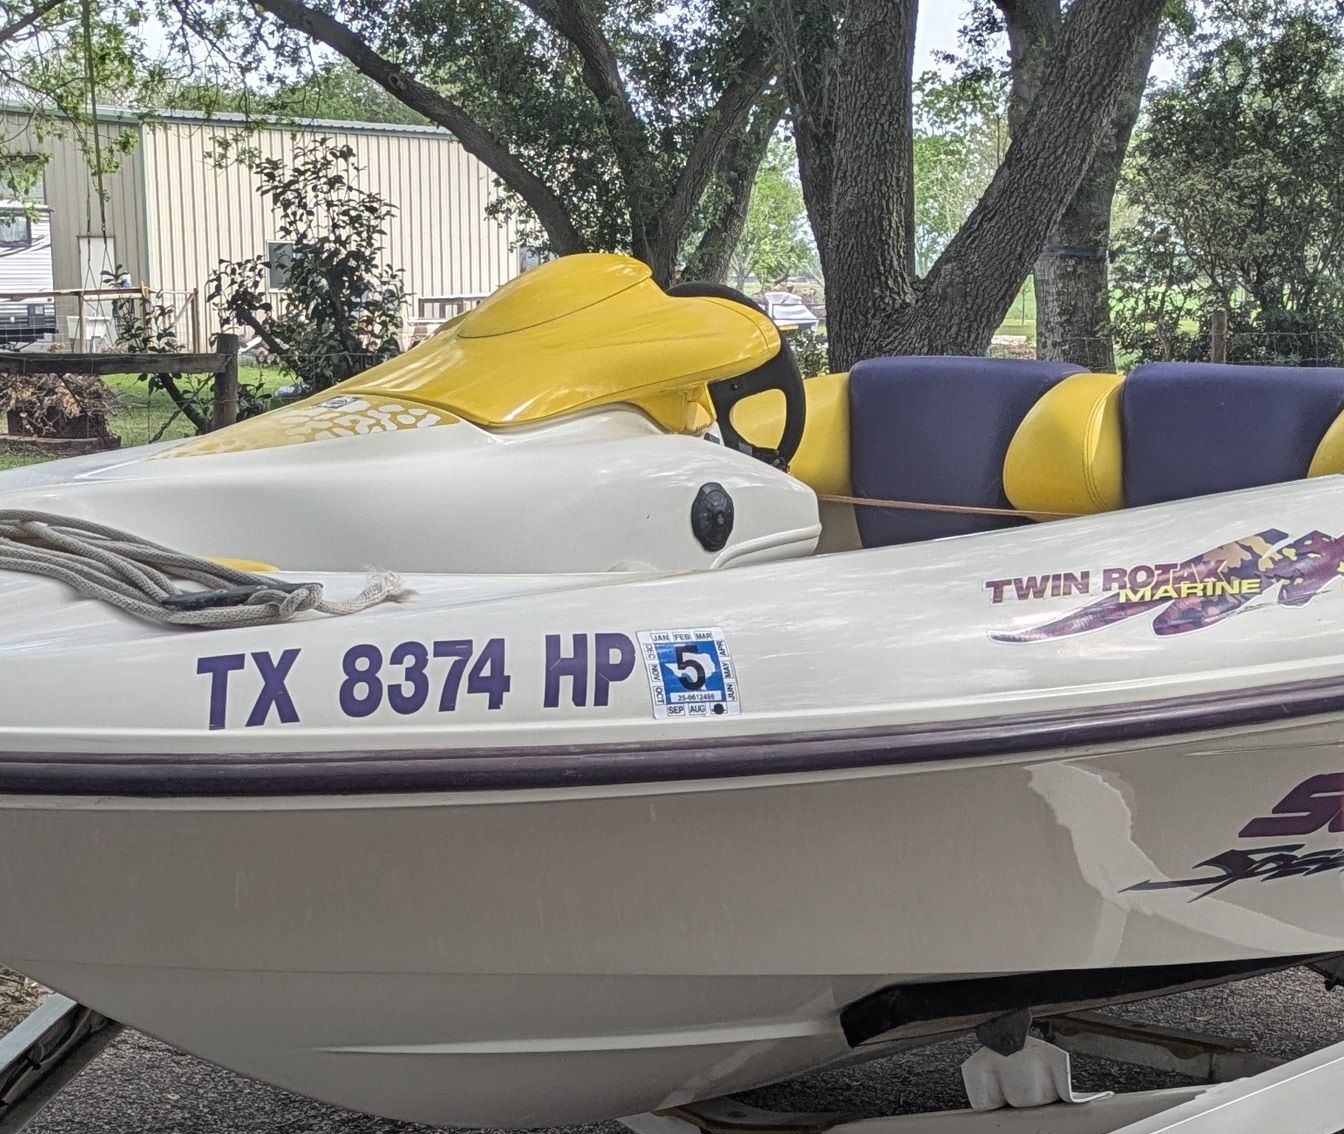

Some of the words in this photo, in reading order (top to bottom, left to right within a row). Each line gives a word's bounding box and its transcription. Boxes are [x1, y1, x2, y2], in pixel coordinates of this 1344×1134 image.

[985, 570, 1090, 604] TWIN
[1101, 560, 1228, 593] ROTAX
[1118, 578, 1262, 603] MARINE
[653, 634, 669, 642] JAN
[673, 633, 691, 641] FEB
[695, 632, 713, 640] MAR
[645, 643, 656, 660] DEC
[716, 640, 727, 656] APR
[651, 664, 661, 681] NOV
[675, 644, 706, 691] 5
[722, 662, 732, 679] MAY
[196, 648, 302, 731] TX
[339, 638, 511, 718] 8374
[543, 633, 636, 709] HP
[655, 687, 665, 704] OCT
[727, 684, 736, 701] JUN
[668, 706, 684, 715] SEP
[690, 705, 706, 713] AUG
